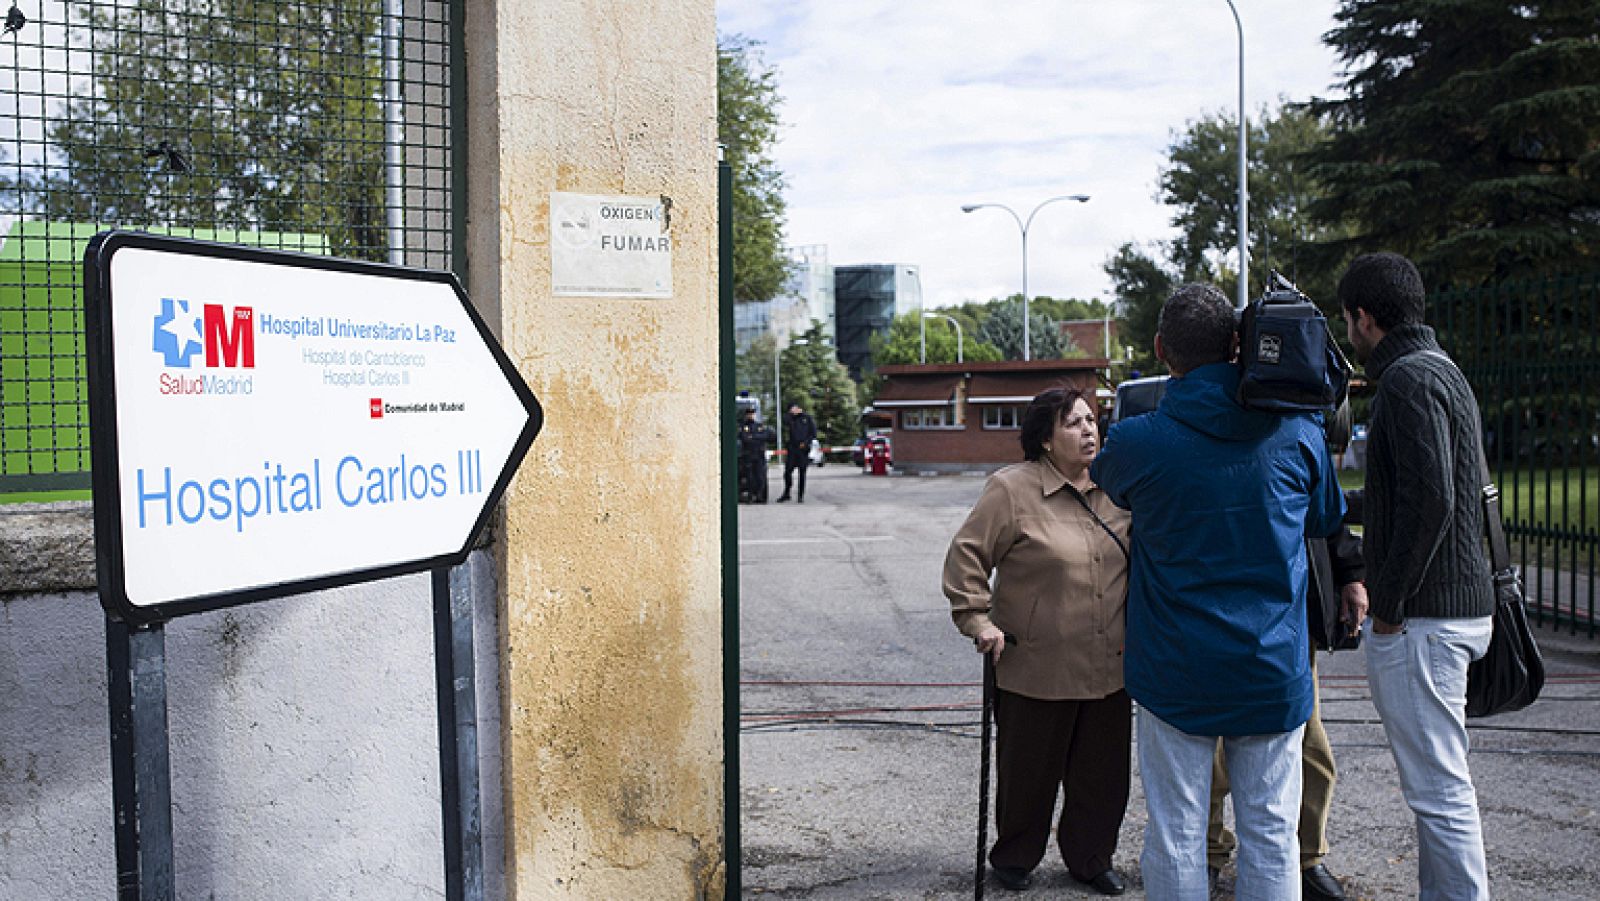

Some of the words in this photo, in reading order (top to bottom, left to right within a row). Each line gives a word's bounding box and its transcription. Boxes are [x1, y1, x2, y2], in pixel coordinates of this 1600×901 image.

[601, 235, 670, 252] FUMAR
[260, 314, 324, 339] Hospital
[328, 318, 413, 341] Universitario
[416, 324, 432, 342] La
[434, 325, 456, 343] Paz
[302, 348, 346, 367] Hospital
[350, 350, 363, 365] de
[365, 351, 426, 367] Cantoblanco
[160, 373, 252, 395] SaludMadrid
[323, 370, 365, 388] Hospital
[368, 370, 400, 387] Carlos
[402, 371, 411, 385] III
[384, 403, 428, 414] Comunidad
[429, 403, 438, 412] de
[439, 402, 465, 412] Madrid
[137, 459, 321, 532] Hospital
[336, 453, 447, 507] Carlos
[458, 450, 482, 495] III
